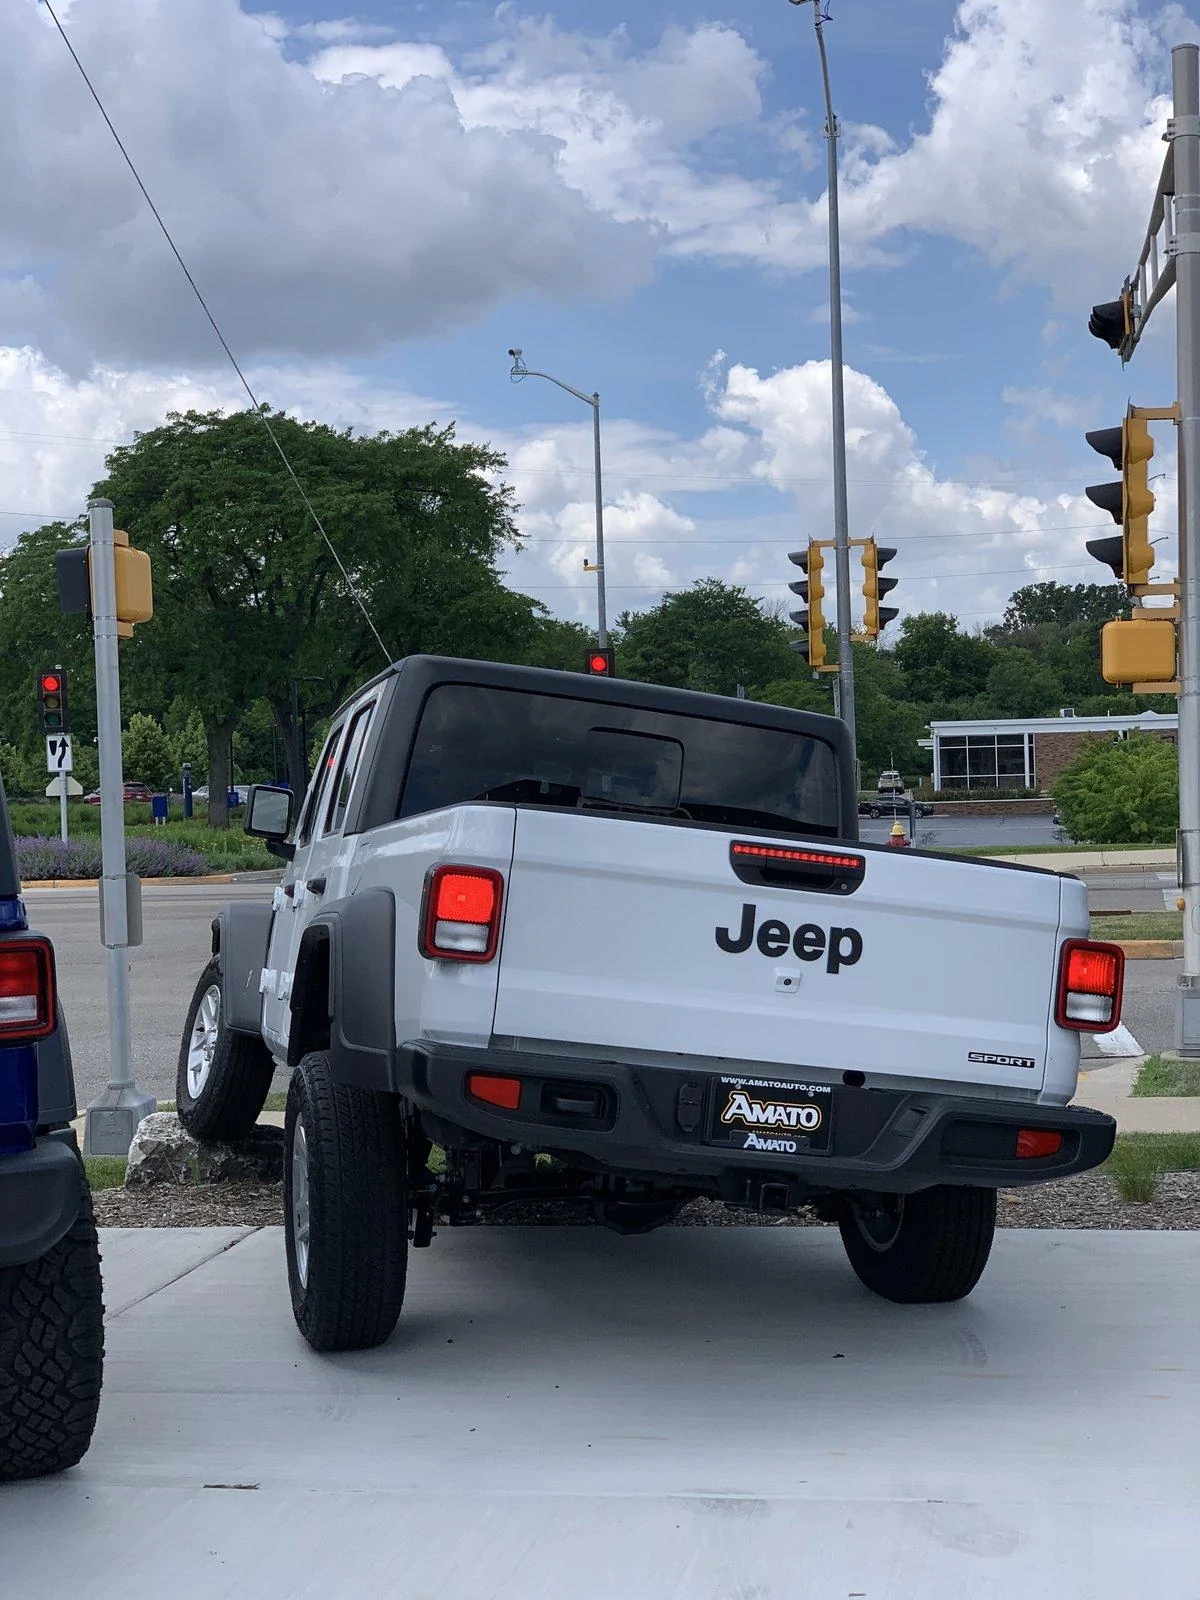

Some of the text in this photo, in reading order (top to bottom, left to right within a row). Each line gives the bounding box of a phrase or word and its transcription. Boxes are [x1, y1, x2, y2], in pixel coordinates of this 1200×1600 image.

[715, 903, 863, 974] Jeep
[969, 1053, 1036, 1067] SPORT
[721, 1076, 831, 1093] WWW.AMATOAUTO.COM
[724, 1094, 819, 1127] AMATO
[743, 1133, 797, 1153] AMATO
